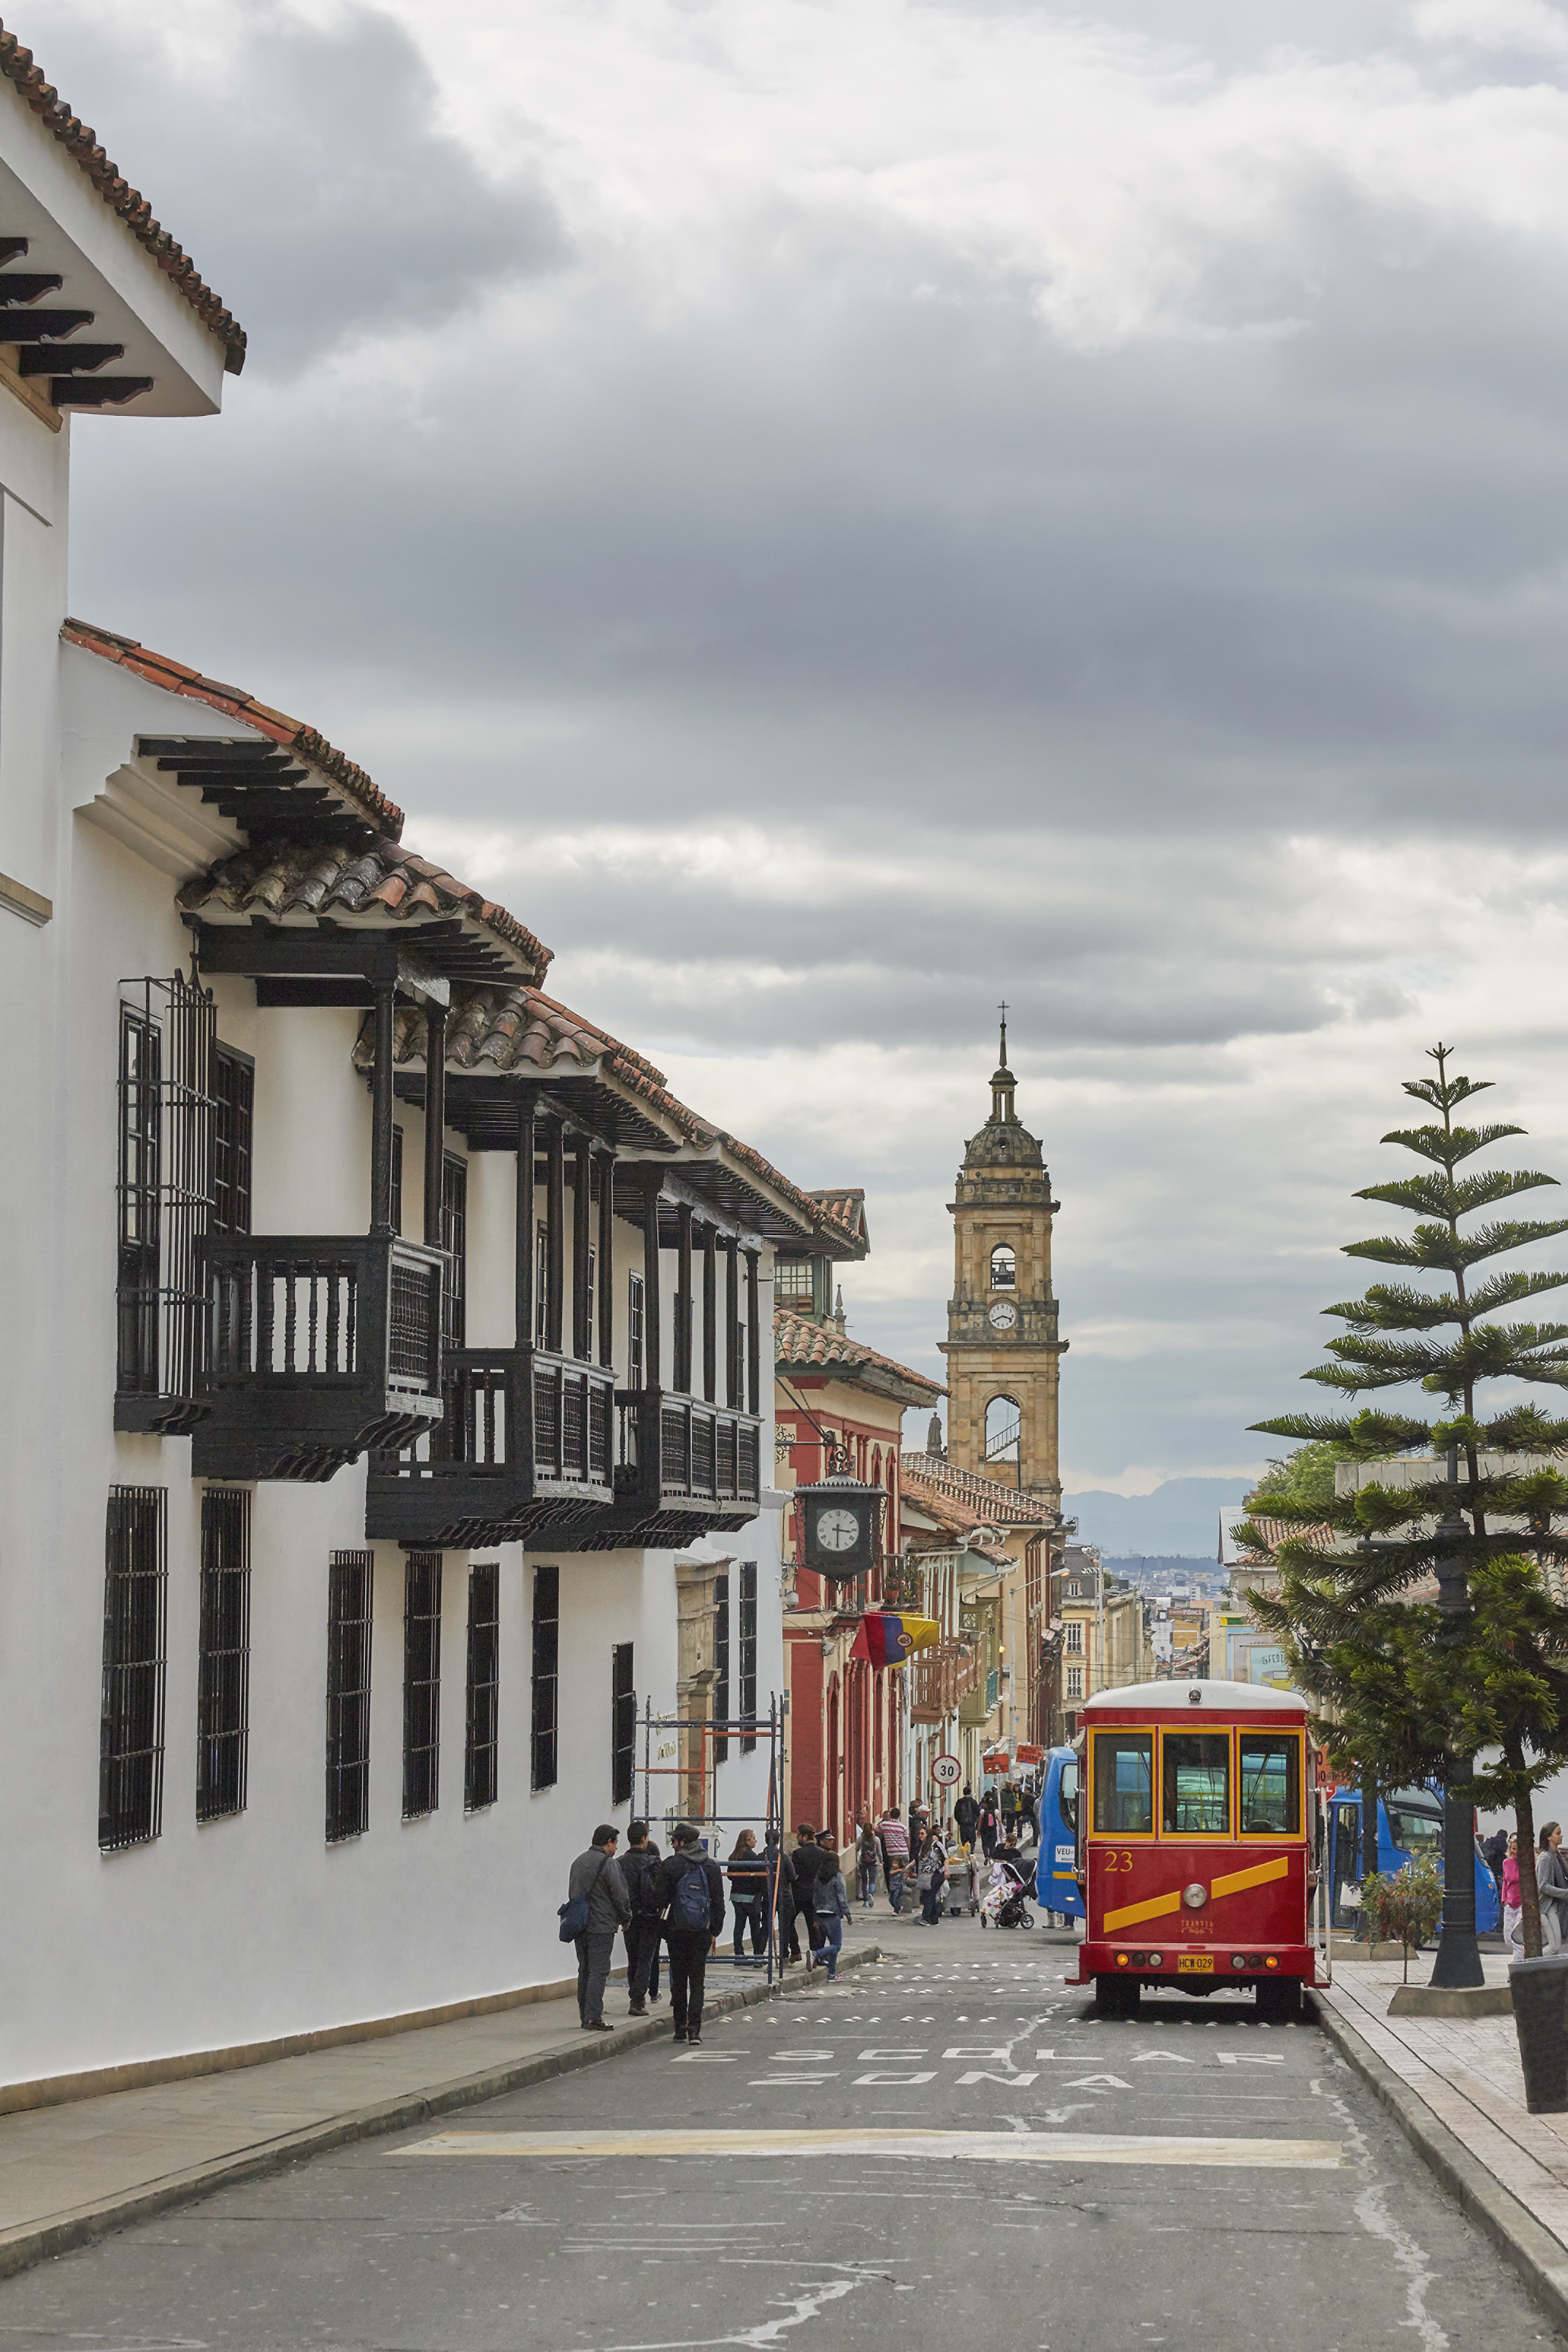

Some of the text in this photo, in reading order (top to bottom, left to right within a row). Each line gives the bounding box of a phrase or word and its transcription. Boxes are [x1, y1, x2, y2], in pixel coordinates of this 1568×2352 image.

[940, 1765, 954, 1777] 30
[1104, 1851, 1133, 1872] 23
[670, 2047, 1287, 2065] ESCOLAR
[746, 2071, 1134, 2089] ZONA
